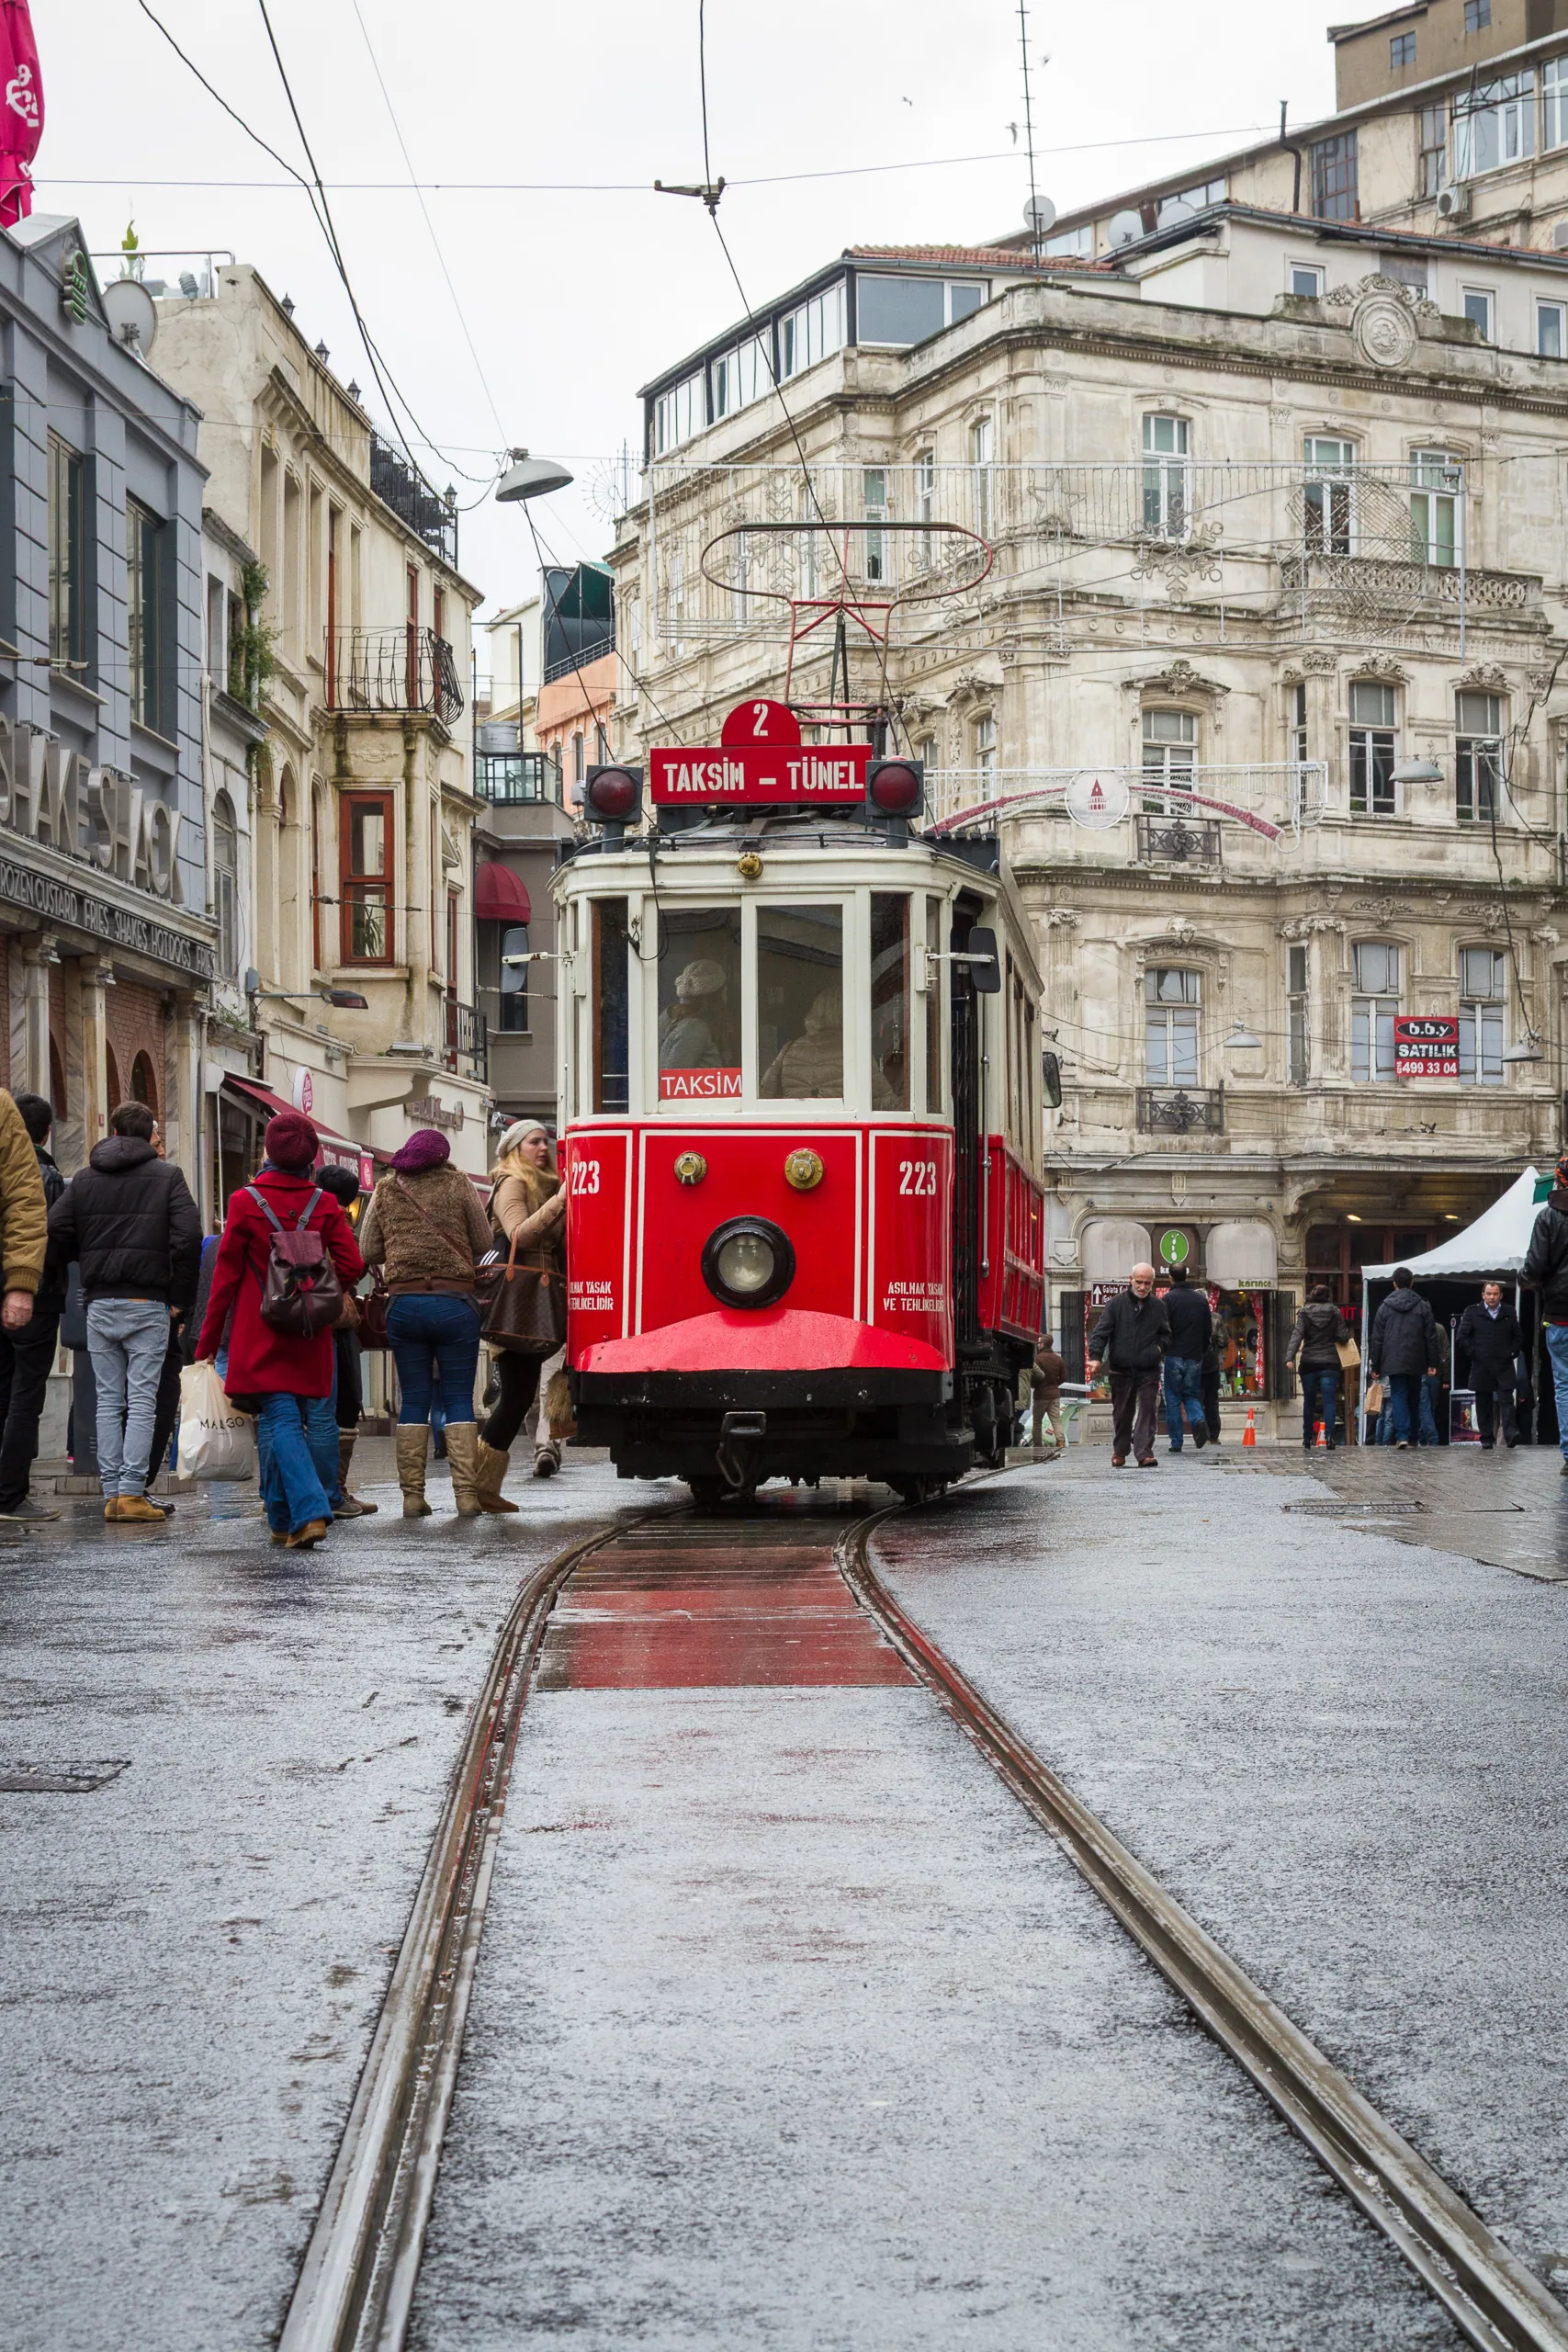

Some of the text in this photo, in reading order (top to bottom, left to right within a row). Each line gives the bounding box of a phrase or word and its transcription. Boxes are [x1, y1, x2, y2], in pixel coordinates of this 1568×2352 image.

[752, 703, 769, 737] 2
[662, 756, 745, 792] TAKSİM
[786, 755, 864, 790] TÜNEL
[88, 767, 184, 904] SHACK
[34, 878, 77, 922] CUSTARD
[84, 898, 109, 935] FRIES
[115, 910, 147, 951] SHAKES
[1398, 1044, 1457, 1057] SATILIK
[660, 1071, 742, 1096] TAKSİM
[1403, 1062, 1424, 1074] 499
[1427, 1062, 1440, 1074] 33
[1443, 1062, 1458, 1074] 04
[572, 1160, 600, 1195] 223
[899, 1161, 936, 1195] 223
[586, 1281, 612, 1294] YASAK
[883, 1297, 897, 1311] VE
